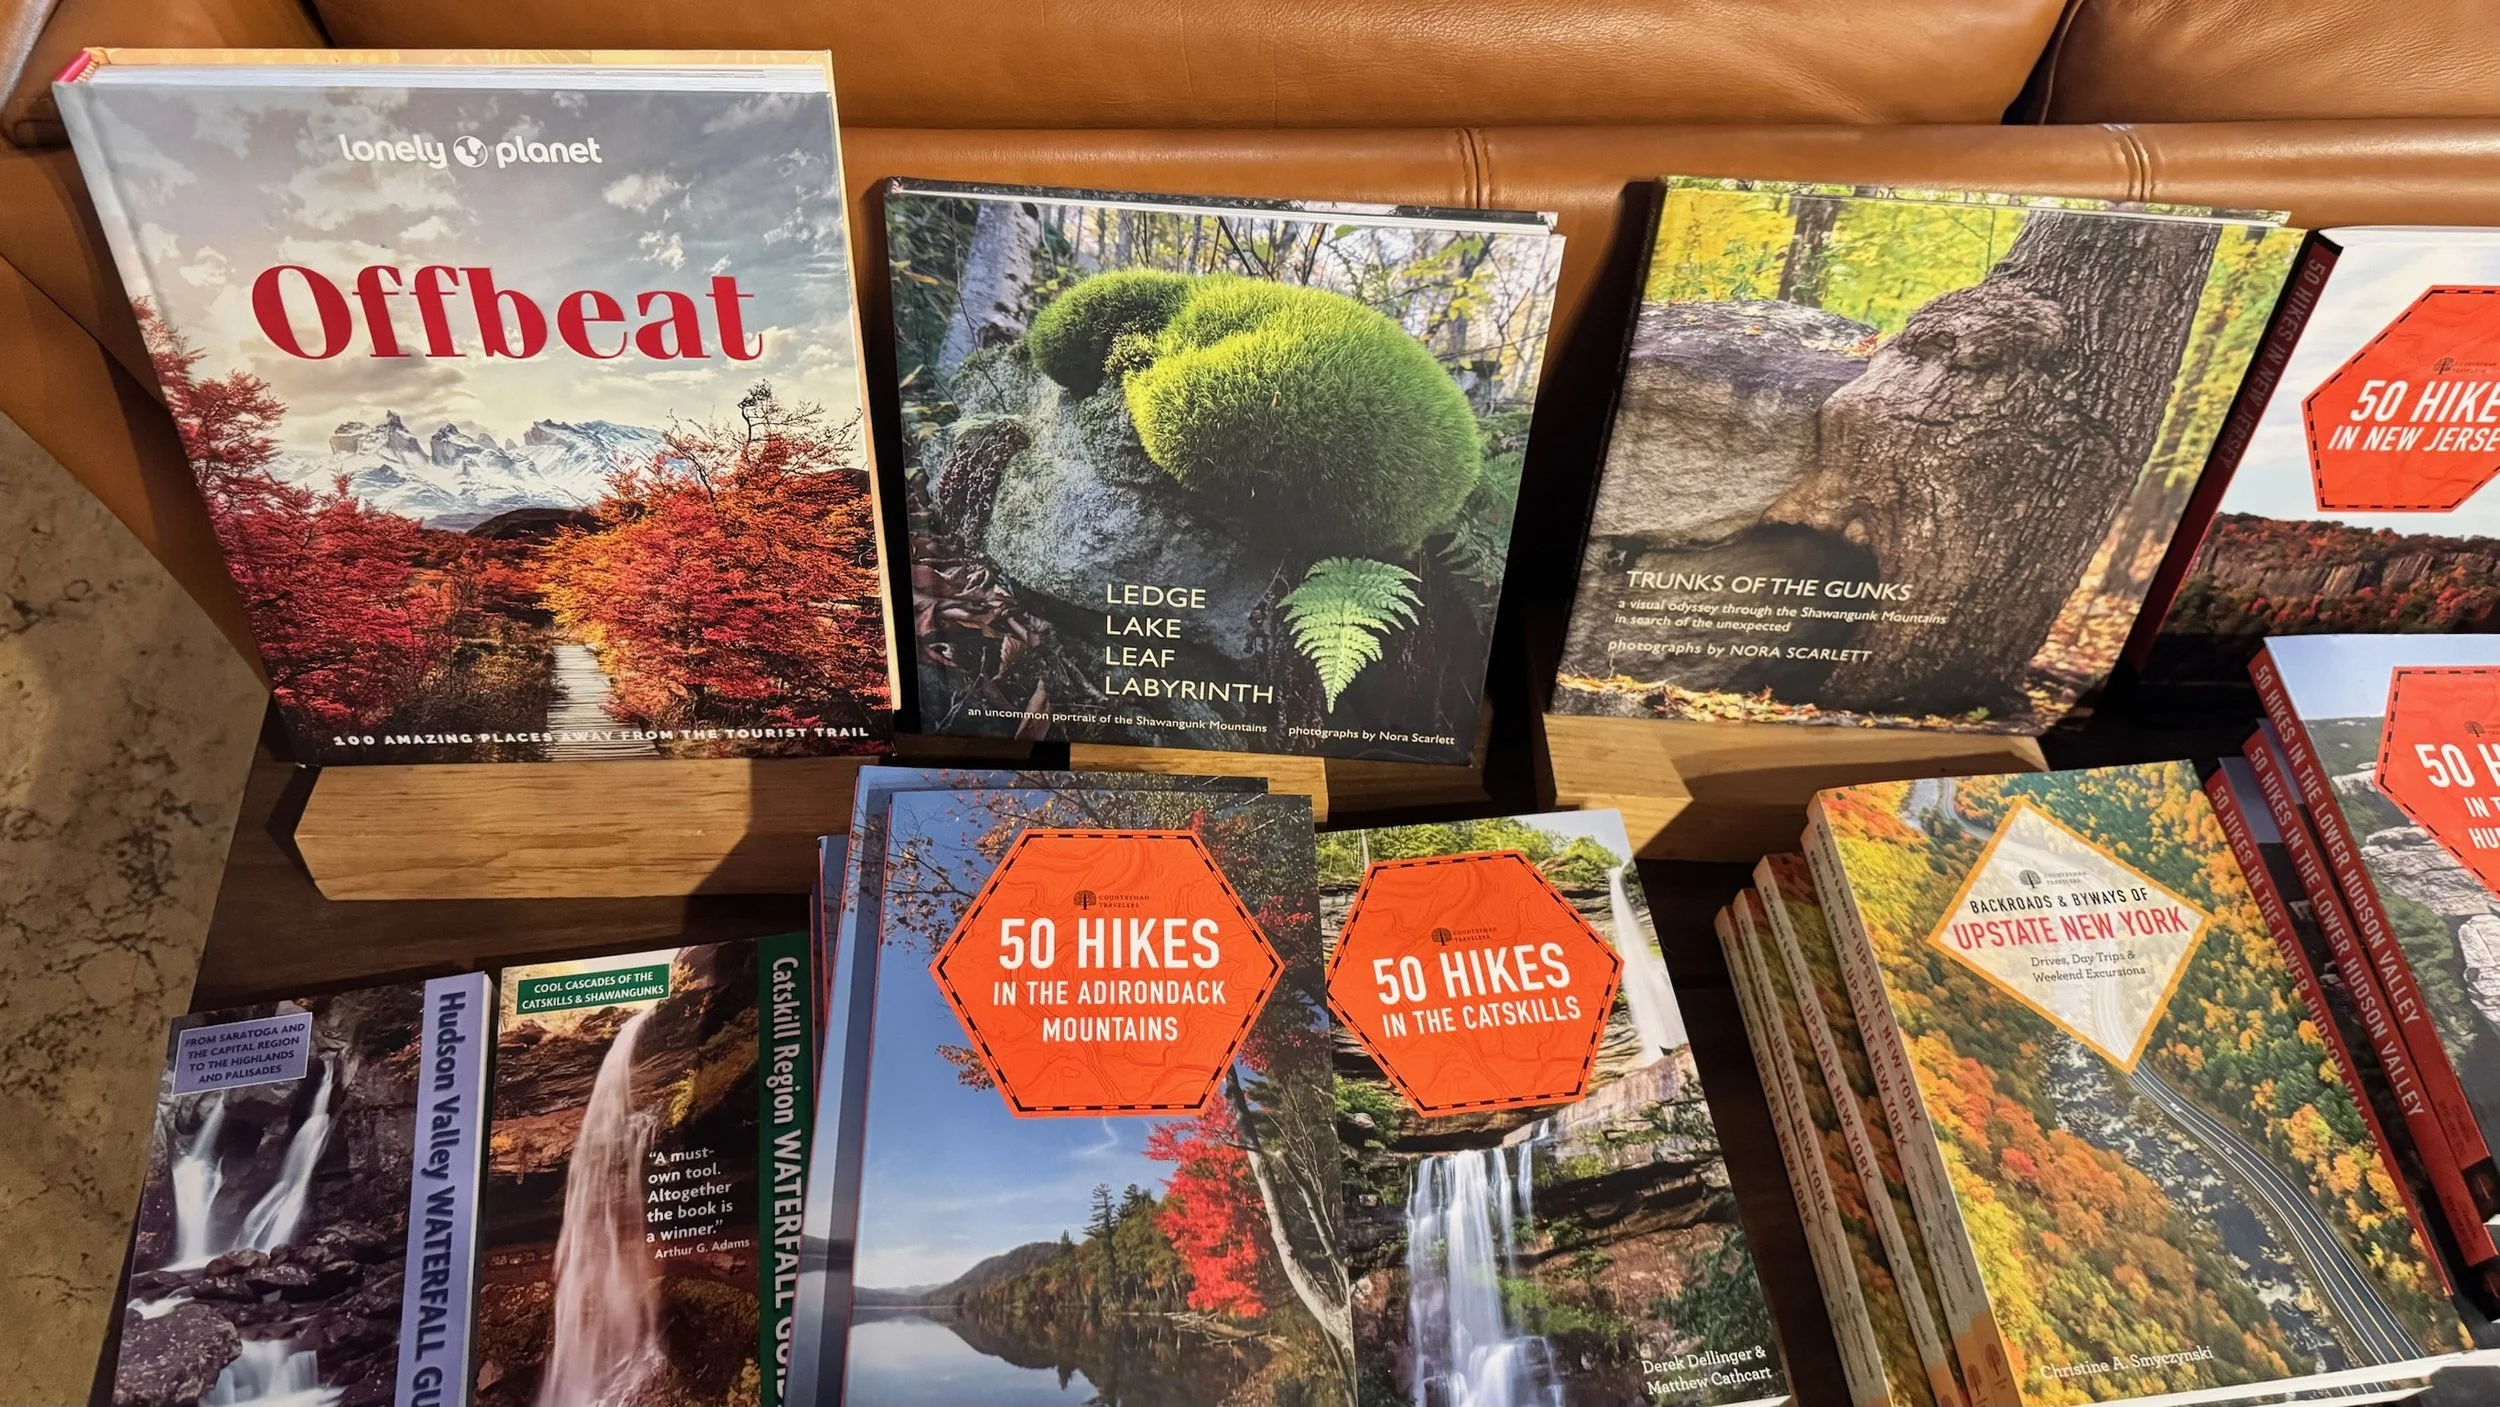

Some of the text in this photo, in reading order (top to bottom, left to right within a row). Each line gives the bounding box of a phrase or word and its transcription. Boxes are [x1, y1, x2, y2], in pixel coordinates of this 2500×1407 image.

[338, 133, 603, 169] lonely planet
[2303, 259, 2326, 285] 50
[251, 264, 764, 362] Offbeat
[2277, 286, 2314, 342] HIKES
[2266, 341, 2286, 366] IN
[2246, 365, 2276, 408] NEW
[2350, 379, 2409, 422] 50
[2327, 425, 2361, 450] IN
[2361, 426, 2424, 451] NEW
[1106, 583, 1207, 609] LEDGE
[1626, 570, 1913, 601] TRUNKS OF THE GUNKS
[1614, 614, 1791, 633] in search of the unexpected
[1618, 599, 1948, 625] a visual odyssey through the Shawangunk Mountains
[1106, 615, 1181, 639] LAKE
[1105, 646, 1175, 668] LEAF
[1608, 639, 1873, 662] photographs by NORA SCARLETT
[1105, 676, 1274, 704] LABYRINTH
[967, 707, 1267, 733] an uncommon portrait of the Shawangunk Mountains
[333, 726, 870, 746] 100 AMAZING PLACES AWAY FROM THE TOURIST TRAIL
[1288, 726, 1456, 745] photographs by Nora Scarlett
[2414, 743, 2476, 788] 50
[2463, 796, 2491, 818] IN
[2213, 785, 2229, 809] 50
[2223, 810, 2254, 866] HIKES
[2247, 865, 2264, 890] IN
[2259, 889, 2281, 928] THE
[2256, 664, 2420, 1024] 50 HIKES IN THE LOWER HUDSON VALLEY
[1970, 887, 2148, 914] BACKROADS & BYWAYS OF
[1952, 906, 2189, 950] UPSTATE NEW YORK
[2250, 746, 2425, 1116] 50 HIKES IN THE LOWER HUDSON VALLEY
[999, 916, 1220, 970] 50 HIKES
[2031, 950, 2136, 968] Drives, Day Trips &
[534, 971, 653, 993] COOL CASCADES OF THE
[1372, 942, 1571, 1005] 50 HIKES
[2032, 966, 2146, 984] Weekend Excursions
[522, 985, 664, 1010] CATSKILLS & SHAWANGUNKS
[772, 956, 801, 1039] Catskill
[993, 979, 1226, 1006] IN THE ADIRONDACK
[1042, 1016, 1178, 1042] MOUNTAINS
[1382, 995, 1582, 1038] IN THE CATSKILLS
[185, 1023, 306, 1047] FROM SARATOGA AND
[434, 990, 466, 1092] Hudson
[1855, 941, 1921, 1128] UPSTATE NEW YORK
[188, 1036, 300, 1060] THE CAPITAL REGION
[189, 1050, 295, 1072] TO THE HIGHLANDS
[198, 1064, 282, 1084] AND PALISADES
[766, 1043, 801, 1124] Region
[421, 1094, 461, 1180] Valley
[670, 1147, 715, 1162] must-
[648, 1162, 721, 1184] own tool.
[647, 1182, 732, 1203] Altogether
[646, 1200, 733, 1223] the book is
[773, 1128, 803, 1309] WATERFALL
[646, 1232, 655, 1243] a
[654, 1239, 751, 1259] Arthur G. Adams
[414, 1185, 455, 1362] WATERFALL
[1641, 1345, 1766, 1375] Derek Dellinger &
[2039, 1345, 2214, 1380] Christine A. Smyczynski
[1646, 1366, 1772, 1396] Matthew Cathcart
